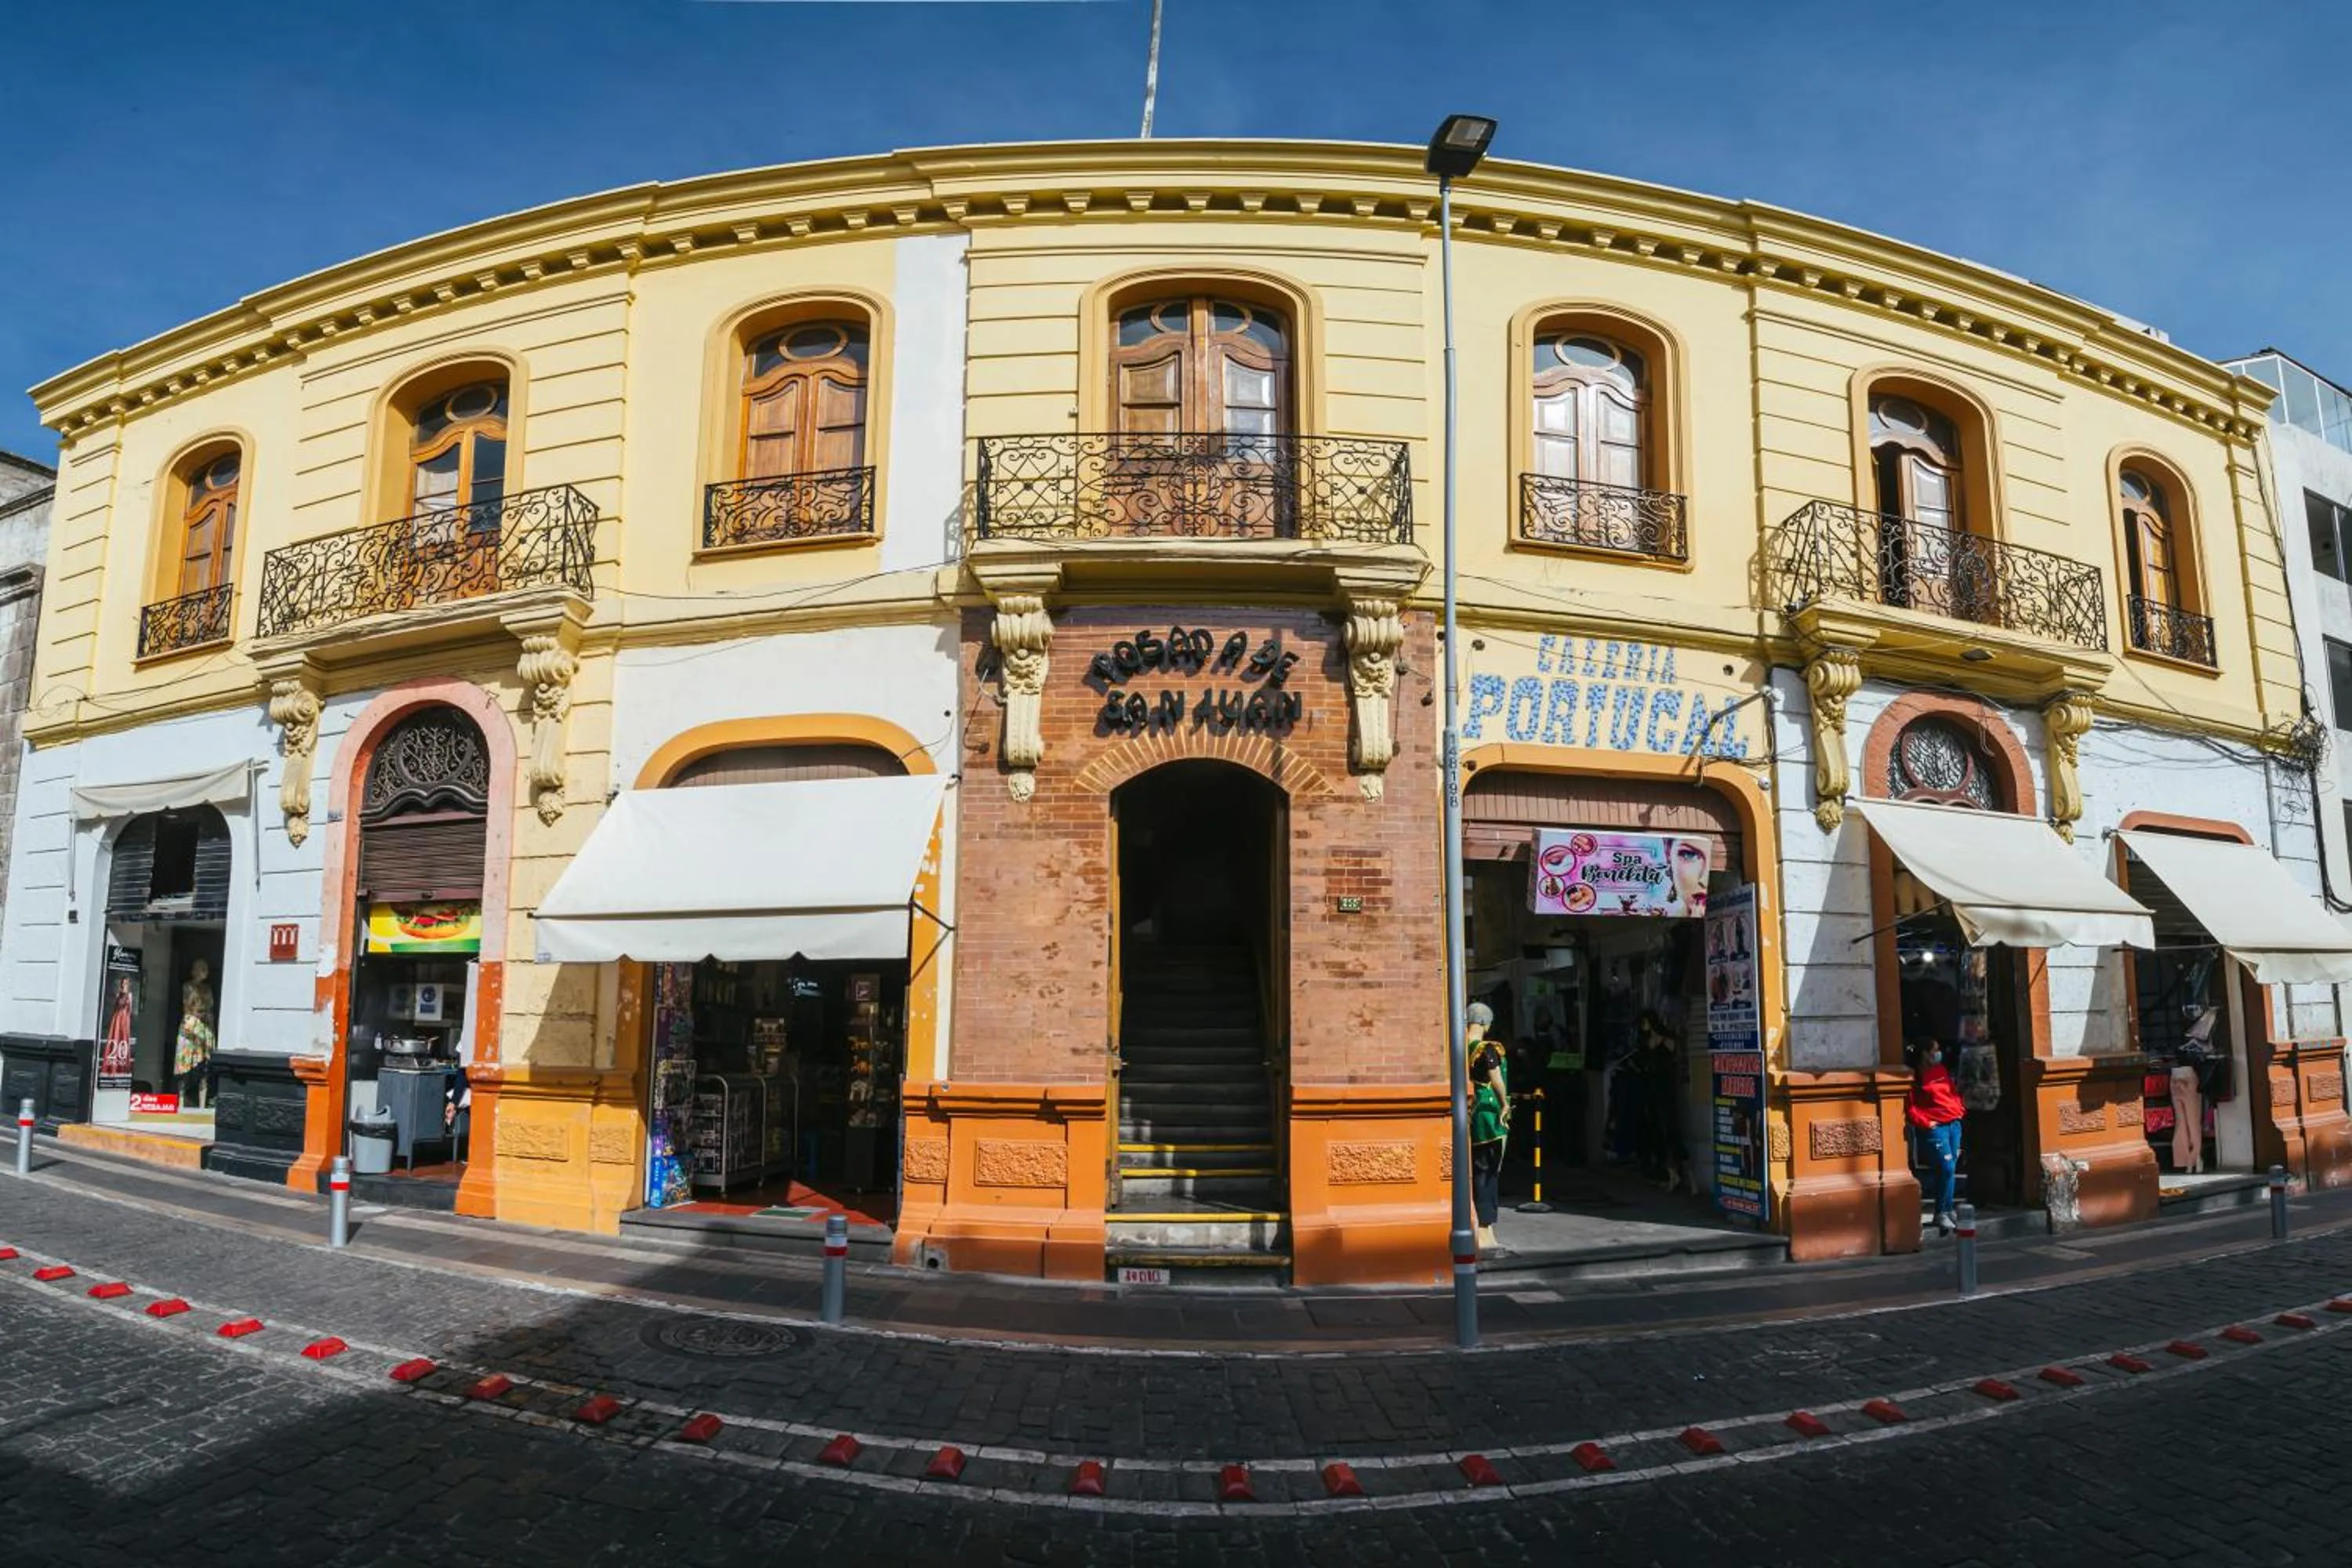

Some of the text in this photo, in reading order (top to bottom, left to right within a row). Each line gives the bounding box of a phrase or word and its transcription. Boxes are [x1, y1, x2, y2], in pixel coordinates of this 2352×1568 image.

[1091, 625, 1301, 685] POSADA DE
[1106, 687, 1302, 730] SAN JUAN
[1461, 673, 1750, 760] PORTUGAL
[1612, 851, 1642, 866] Spa
[106, 1040, 129, 1059] 20
[130, 1094, 142, 1111] 2
